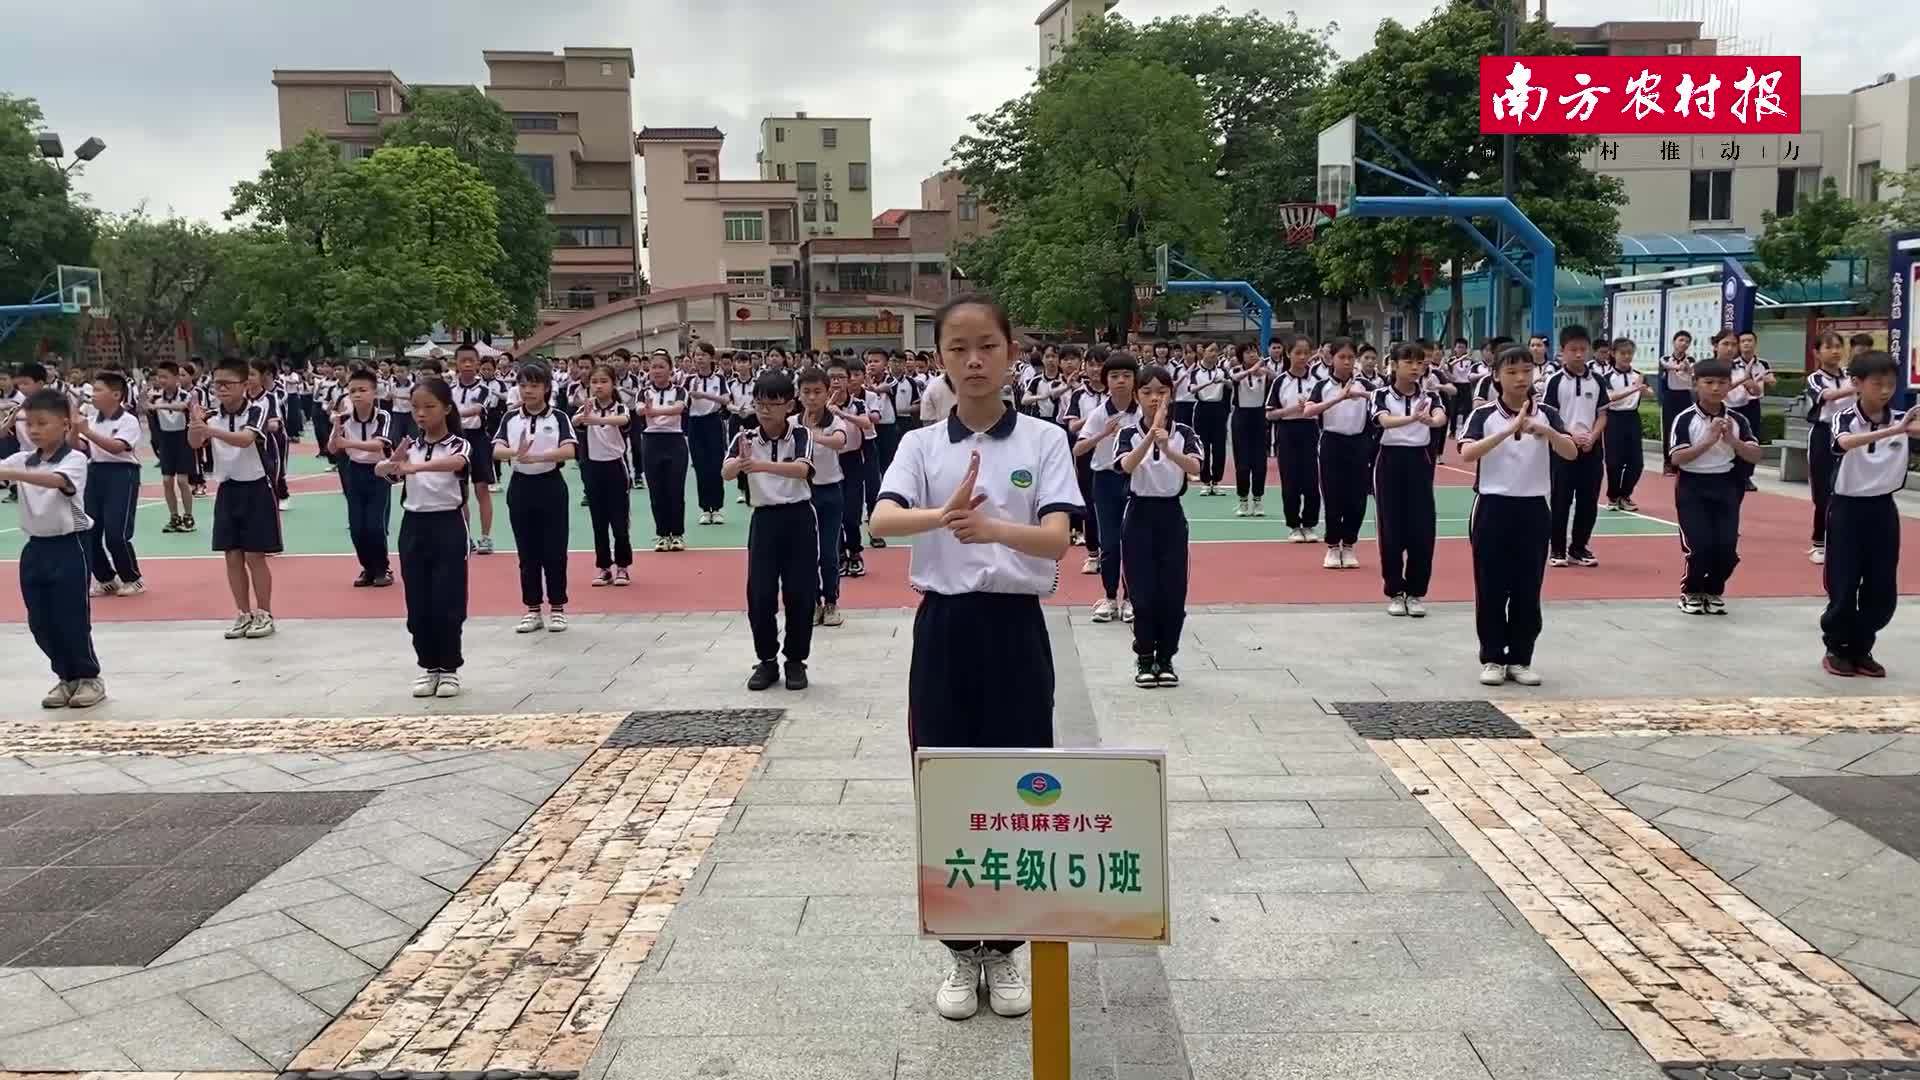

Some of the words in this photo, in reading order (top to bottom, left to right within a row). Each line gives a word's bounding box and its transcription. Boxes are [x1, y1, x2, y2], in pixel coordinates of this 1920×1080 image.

[969, 812, 1114, 833] 里水镇麻奢小学
